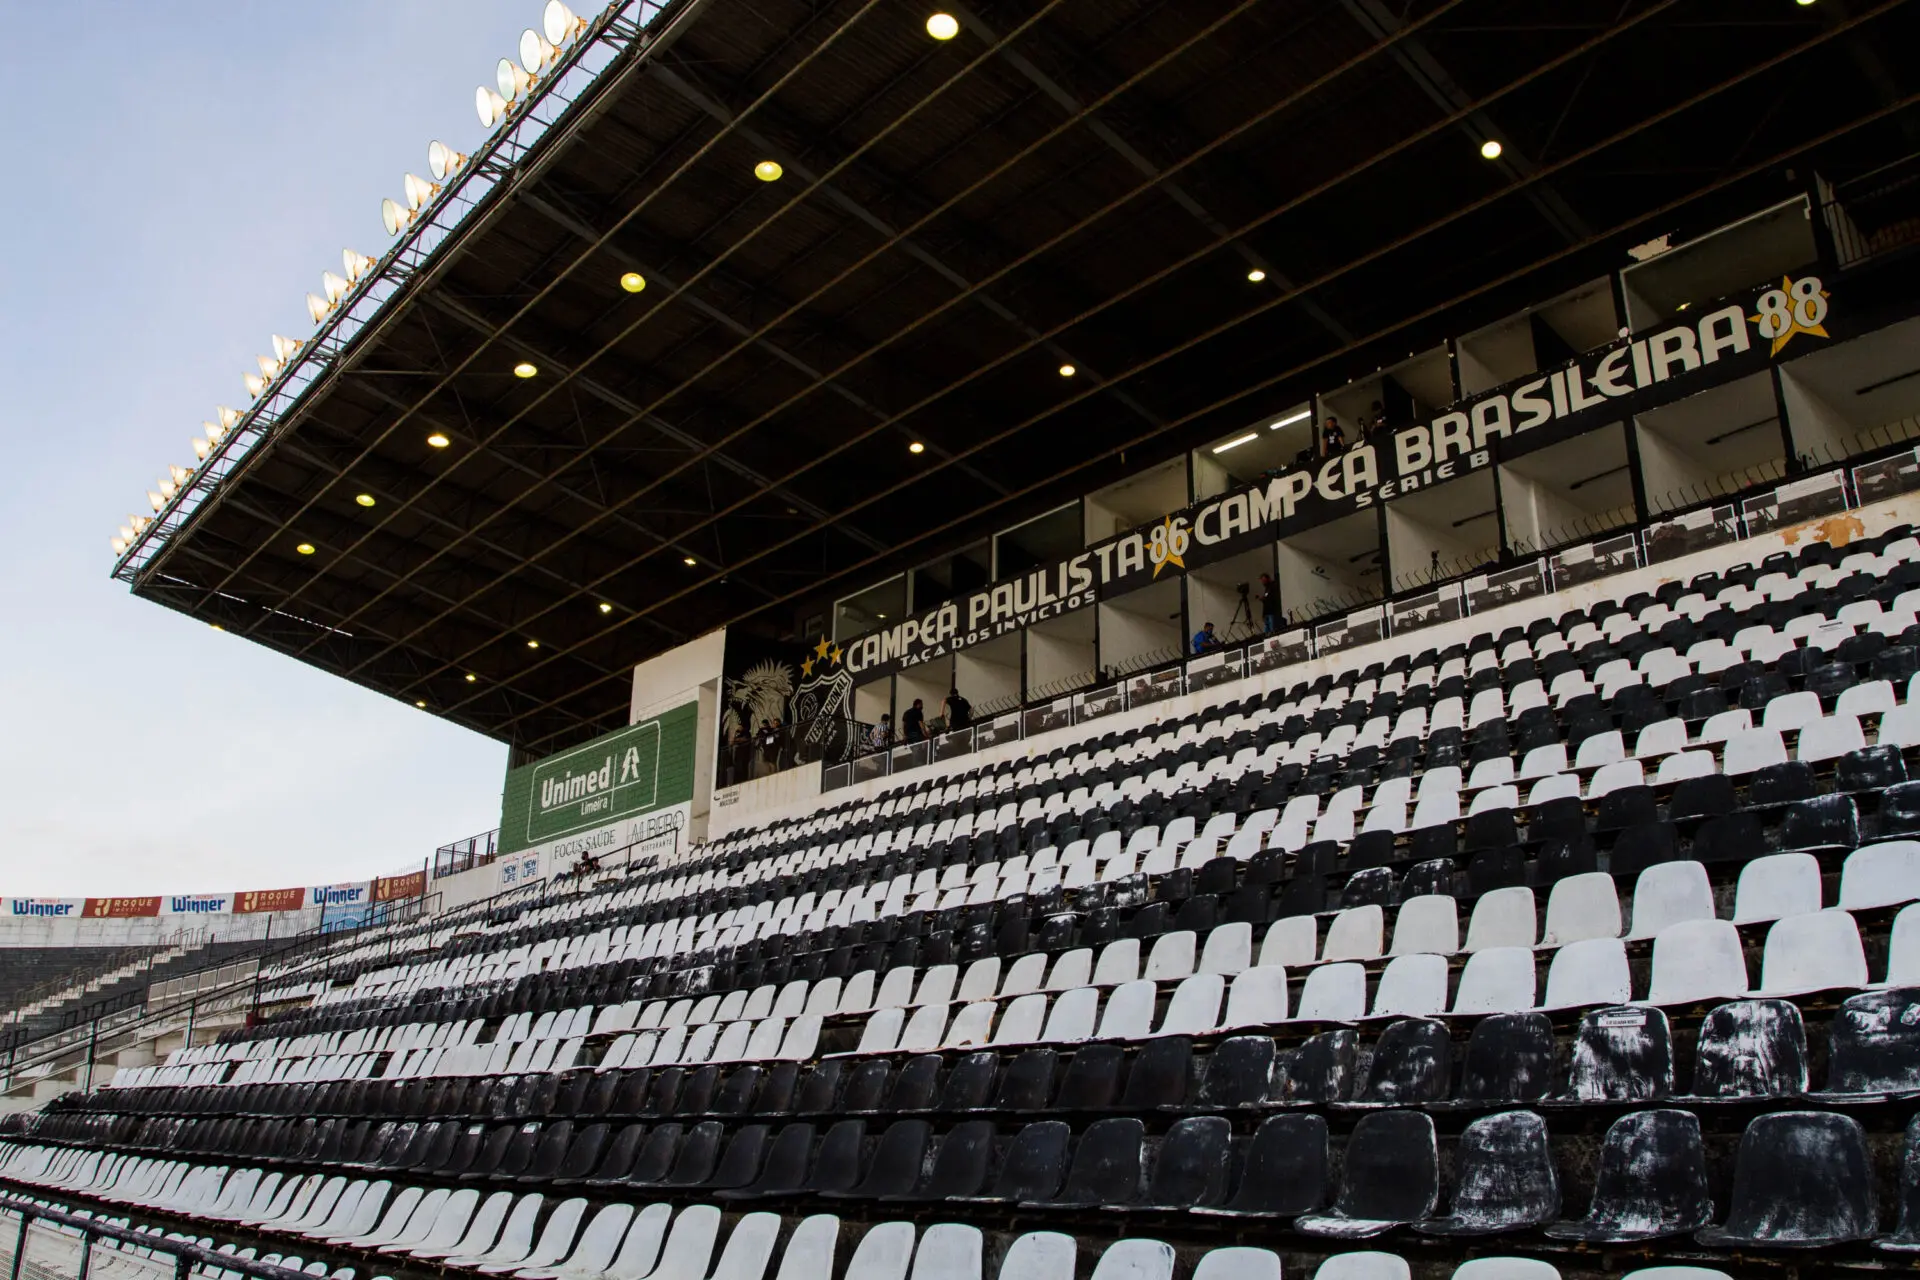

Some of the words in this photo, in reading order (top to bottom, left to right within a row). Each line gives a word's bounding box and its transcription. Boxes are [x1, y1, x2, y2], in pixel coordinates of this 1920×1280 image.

[1395, 305, 1750, 462] BRASILEIRA
[1757, 277, 1828, 339] 88
[1355, 466, 1455, 509] SÉRIE
[1470, 450, 1489, 468] B
[846, 600, 958, 673] CAMPEÃ
[969, 533, 1144, 631] PAULISTA
[1149, 517, 1190, 564] 86
[900, 644, 946, 667] TAÇA
[951, 630, 990, 649] DOS
[996, 589, 1096, 635] INVICTOS
[541, 756, 612, 808] Unimed
[580, 796, 608, 815] Limeira
[554, 843, 585, 860] FOCUS
[585, 829, 616, 851] SAÚDE
[503, 866, 517, 878] NEW
[522, 868, 537, 879] LIFE
[523, 858, 537, 871] NEW
[392, 874, 421, 888] ROQUE
[503, 874, 516, 884] LIFE
[114, 899, 153, 907] ROQUE
[260, 890, 296, 901] ROQUE
[313, 886, 363, 904] Winner
[13, 899, 74, 917] Winner
[172, 895, 226, 914] Winner
